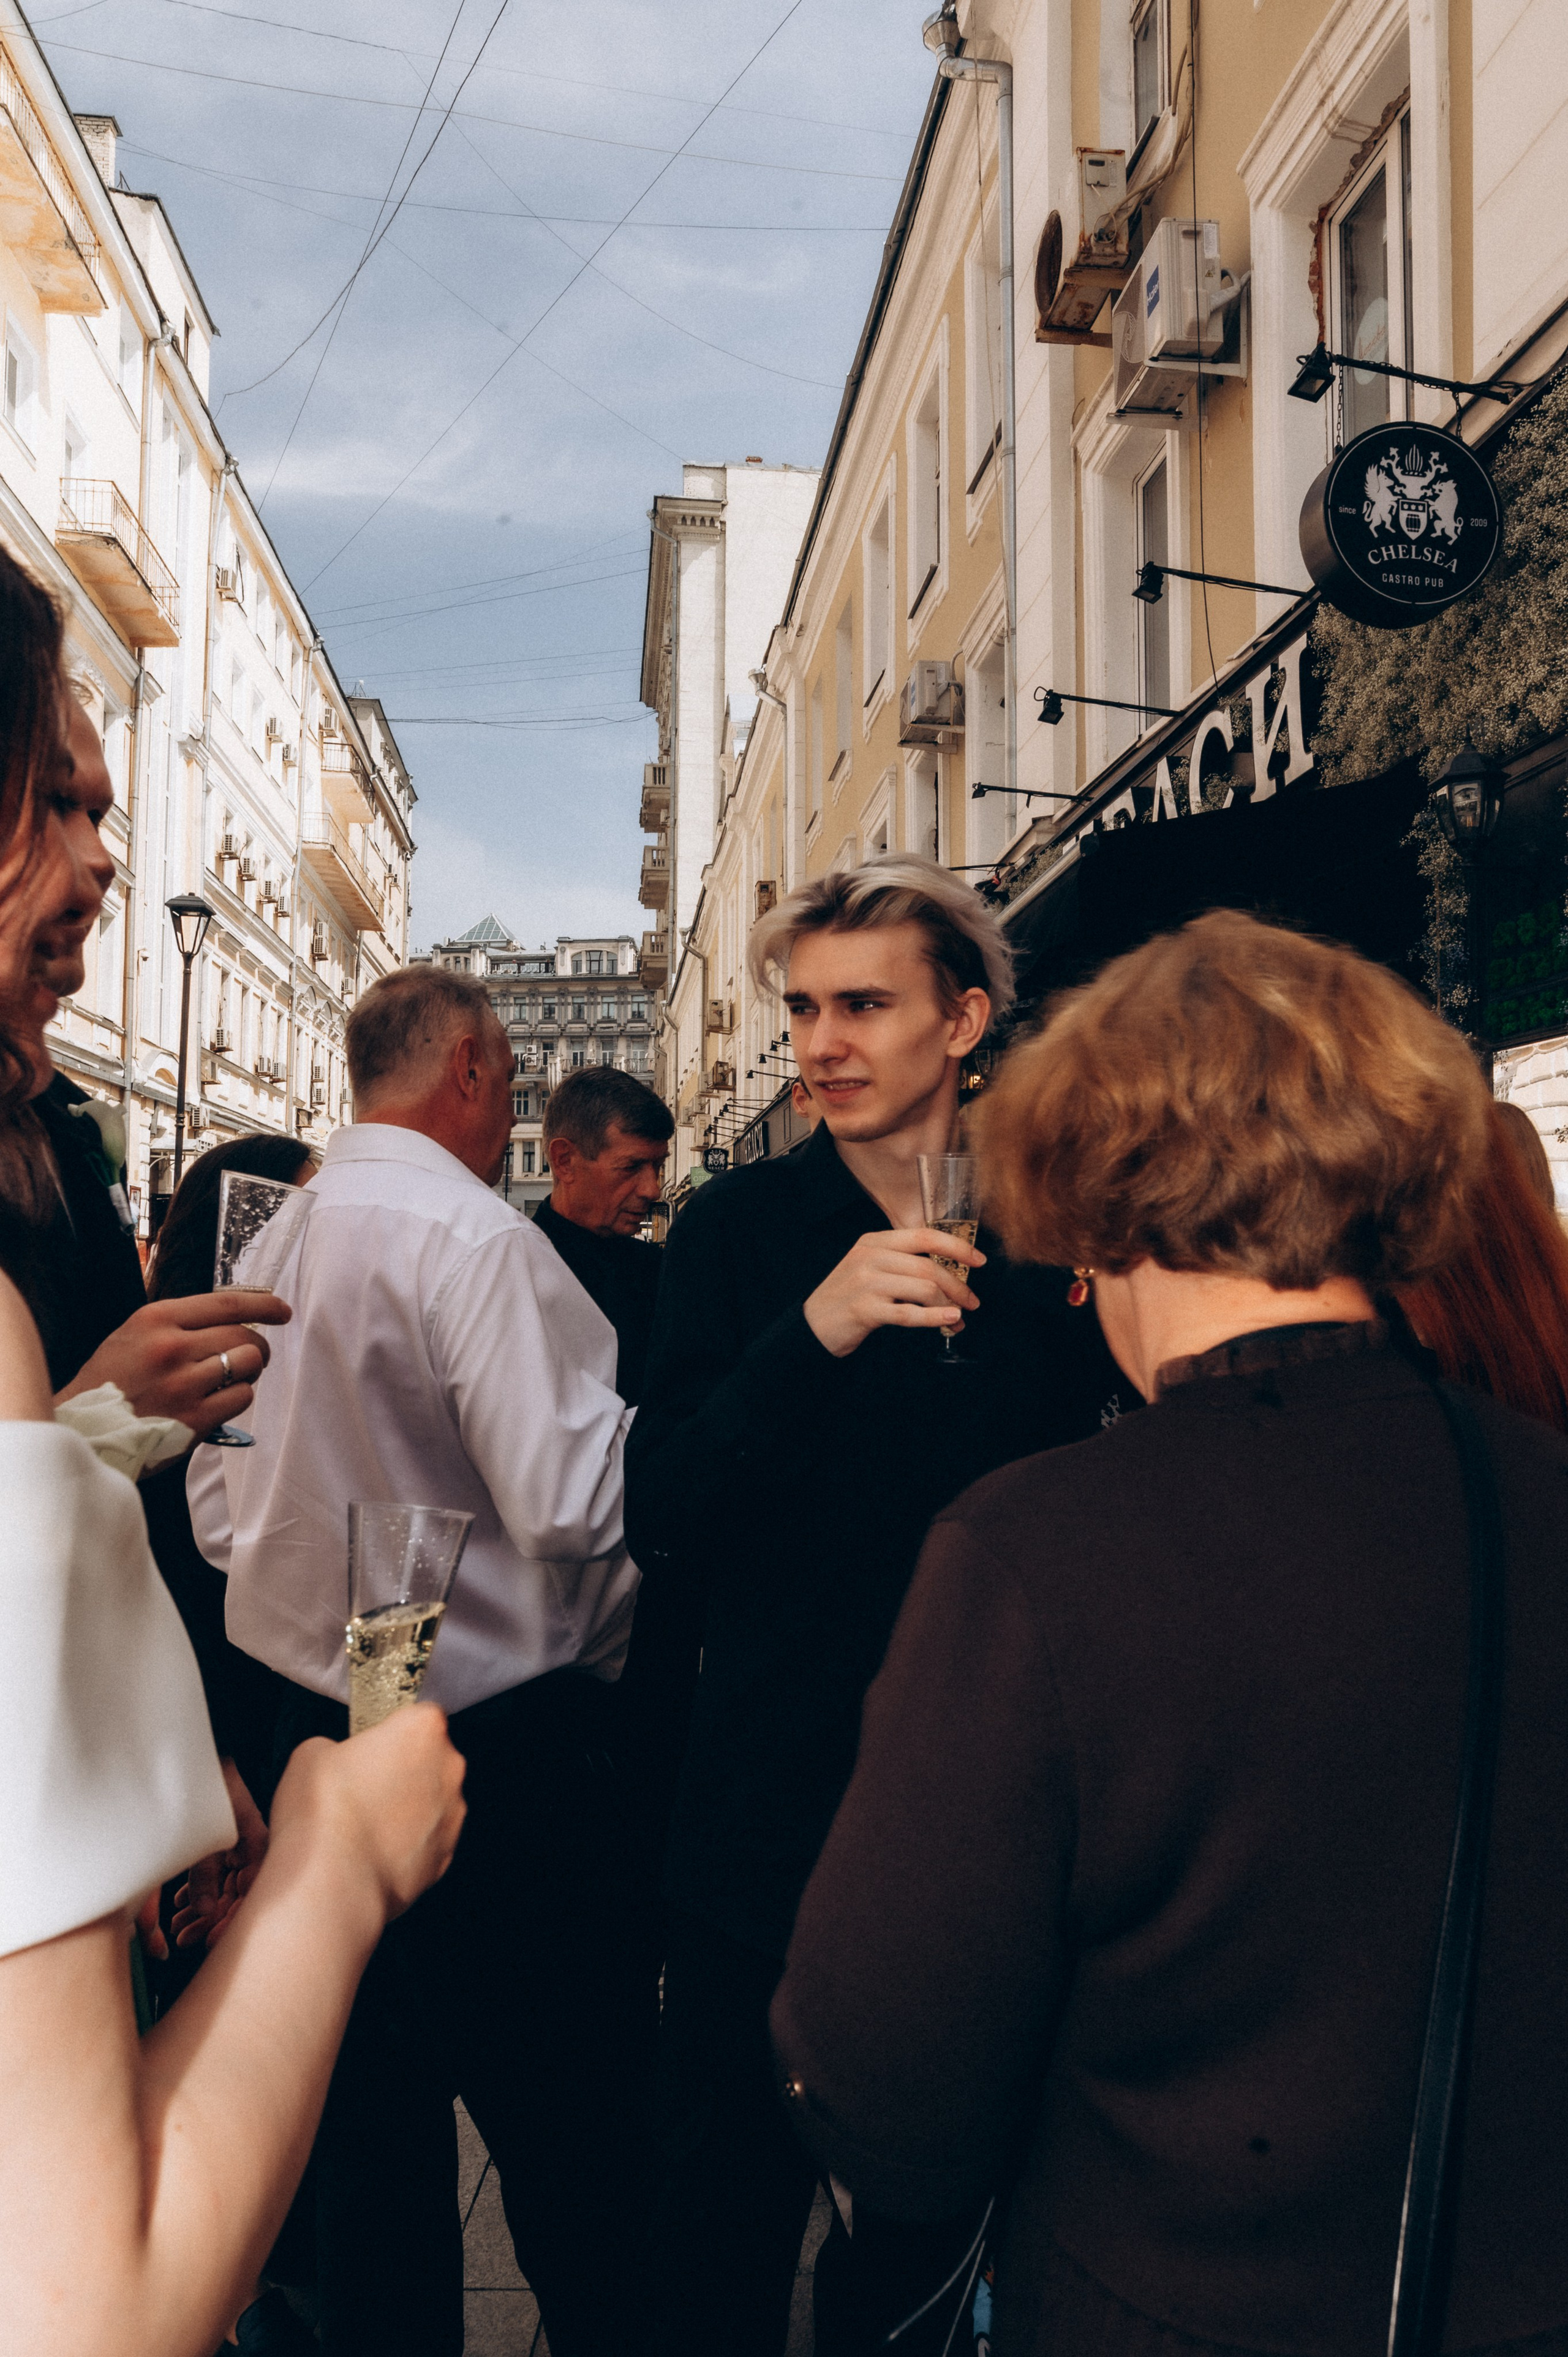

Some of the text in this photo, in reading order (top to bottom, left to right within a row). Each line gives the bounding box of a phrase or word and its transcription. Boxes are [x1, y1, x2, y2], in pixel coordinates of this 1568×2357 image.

[1338, 505, 1488, 527] since 2009
[1368, 545, 1458, 573] CHELSEA
[1382, 573, 1444, 588] GASTRO PUB
